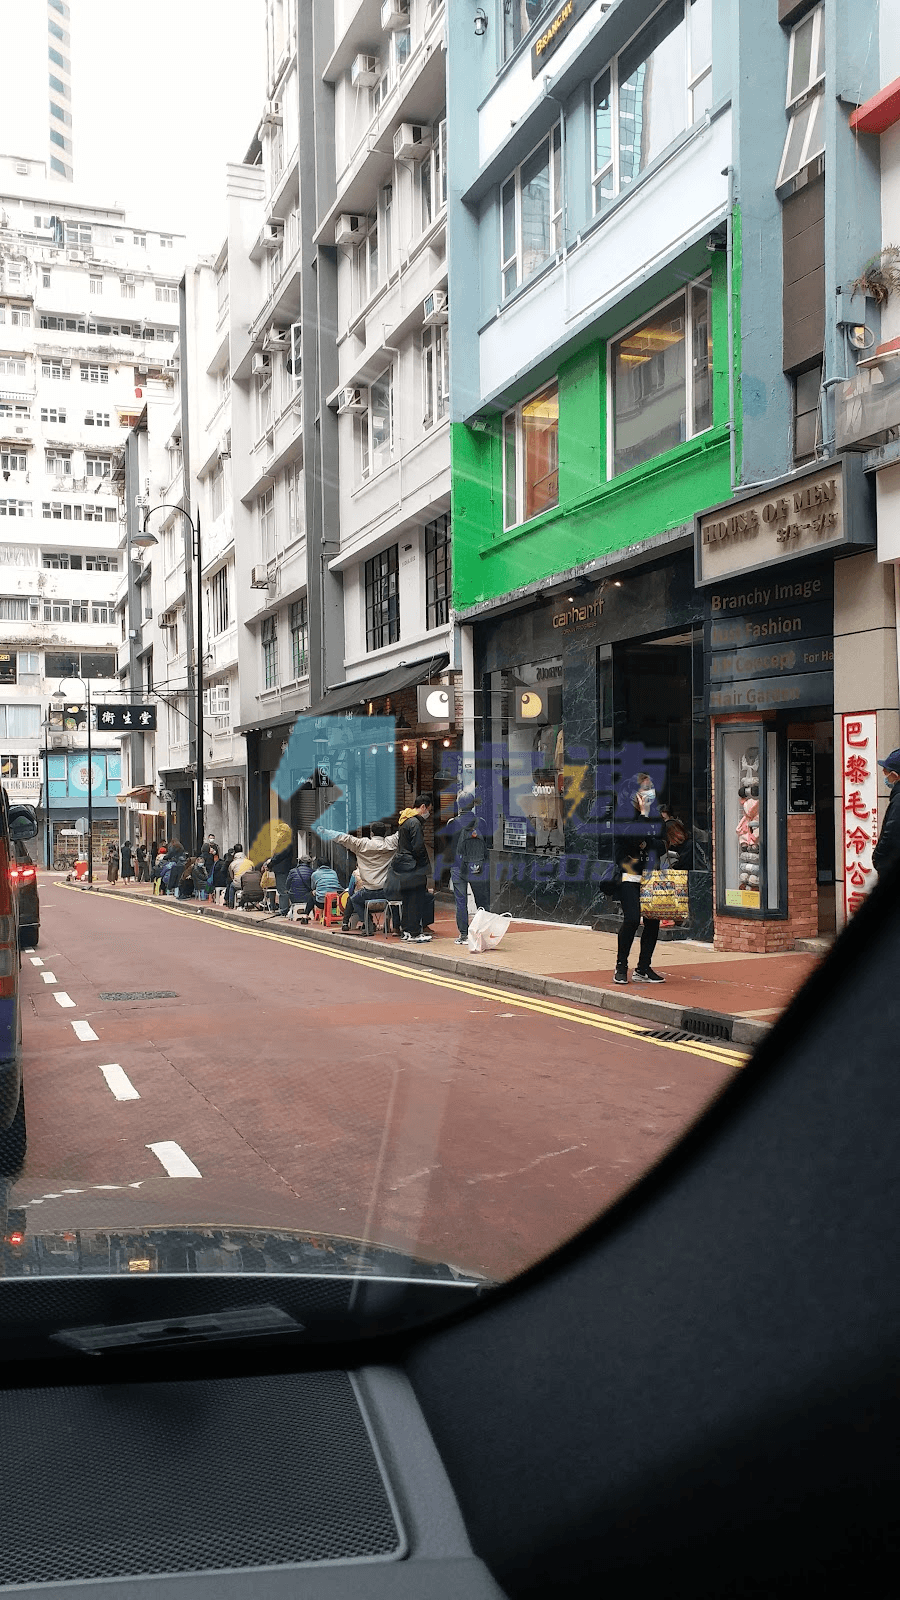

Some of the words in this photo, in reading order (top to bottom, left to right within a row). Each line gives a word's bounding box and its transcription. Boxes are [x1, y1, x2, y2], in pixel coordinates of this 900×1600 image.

[703, 508, 760, 546] HOUSE
[762, 498, 790, 524] OF
[793, 480, 838, 514] MEN
[711, 587, 771, 611] Branchy
[775, 579, 822, 600] Image
[745, 616, 802, 639] Fashion
[803, 653, 820, 664] For
[711, 690, 743, 706] Hair
[746, 687, 800, 704] Garden
